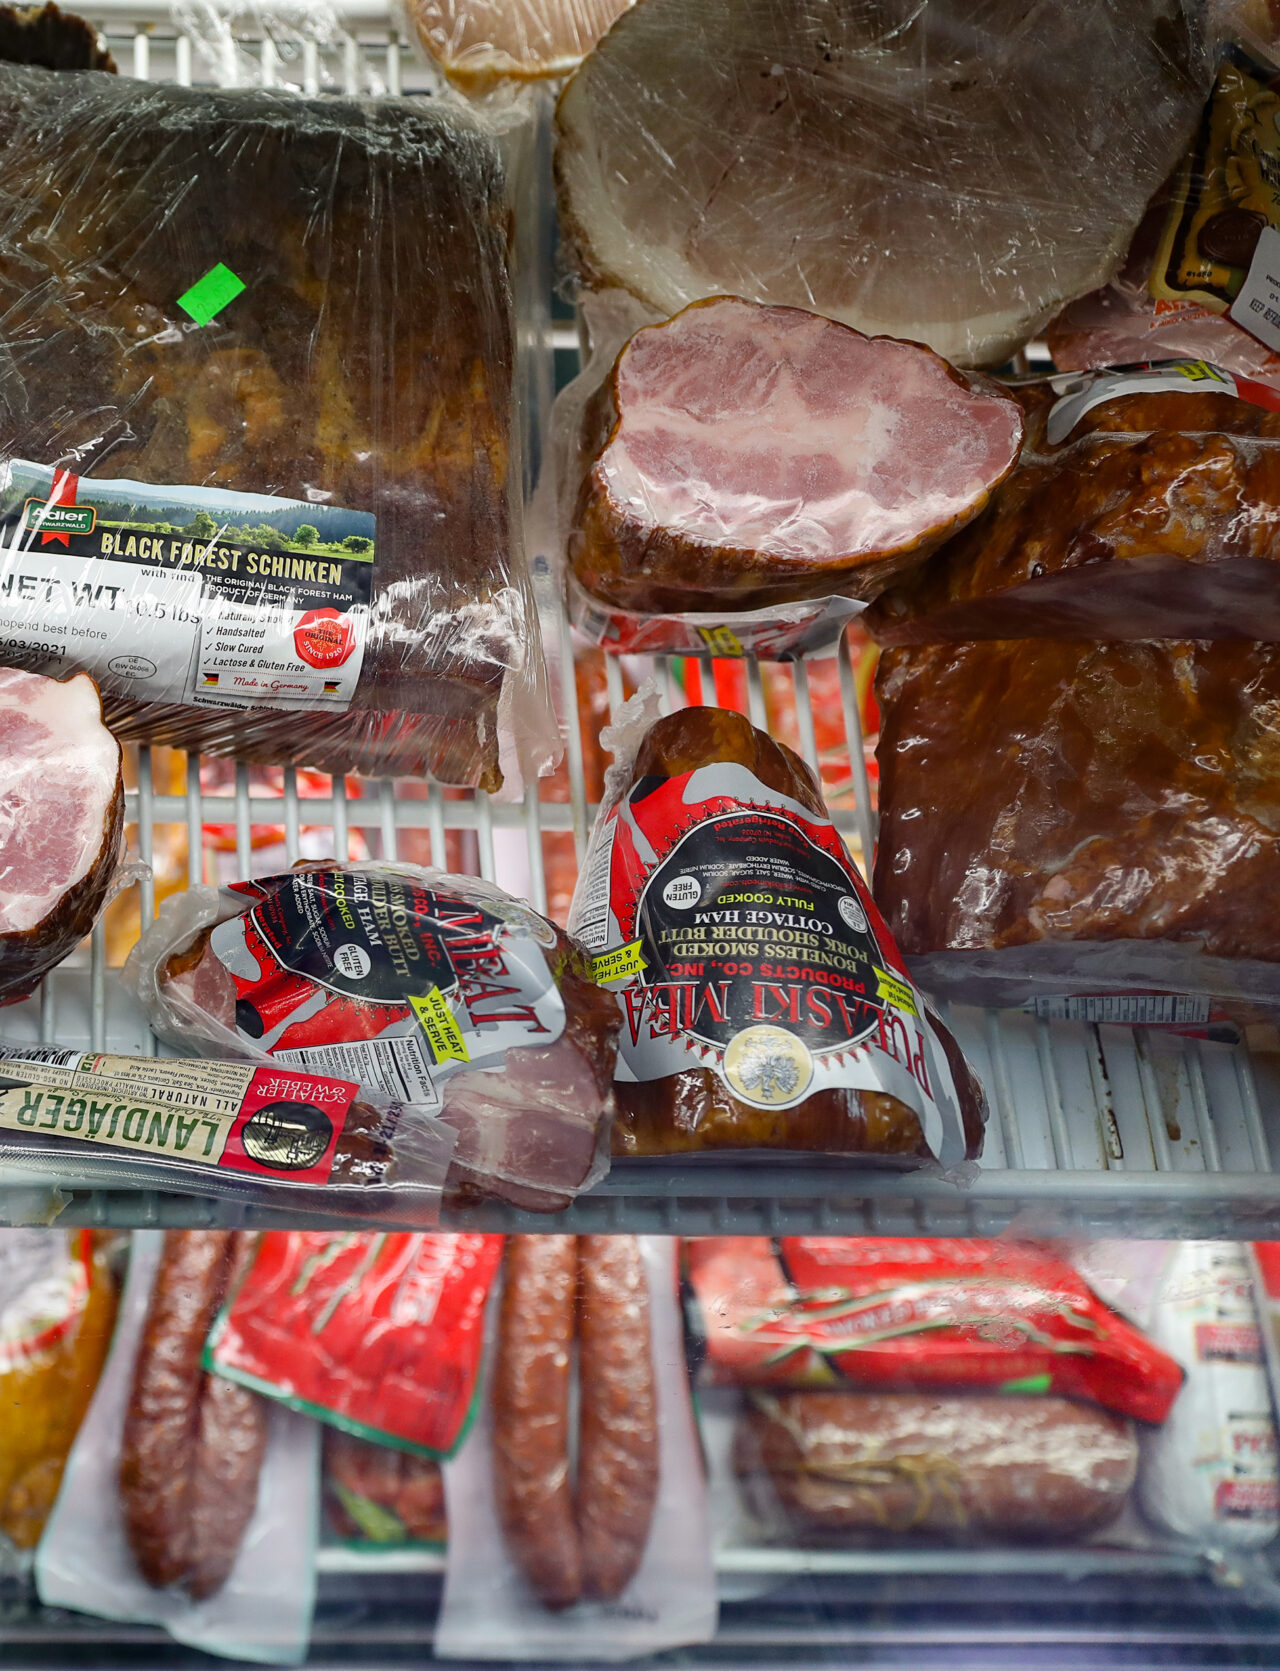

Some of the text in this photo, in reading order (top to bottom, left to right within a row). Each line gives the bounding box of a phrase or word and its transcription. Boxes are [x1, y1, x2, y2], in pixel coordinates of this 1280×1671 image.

[31, 506, 89, 523] Adler
[100, 532, 343, 586] BLACK FOREST SCHINKEN
[140, 568, 167, 580] with
[204, 584, 305, 605] PRODUCT OF GERMANY
[205, 574, 354, 601] THE ORIGINAL BLACK FOREST HAM
[42, 621, 68, 636] best
[215, 626, 266, 639] Handsalted
[304, 631, 344, 646] ORIGINAL
[318, 628, 333, 636] THE
[214, 642, 264, 654] Slow Cured
[303, 640, 343, 660] SINCE 1920
[213, 657, 306, 673] Lactose & Gluten Free
[233, 676, 310, 693] Made in Germany
[192, 695, 249, 710] Schwarzwälder
[699, 863, 726, 871] SODIUM
[769, 856, 789, 865] WATER
[729, 868, 754, 876] SUGAR,
[665, 889, 700, 901] GLUTEN
[672, 883, 694, 892] FREE
[293, 893, 303, 915] ADDED
[335, 883, 357, 931] COOKED
[717, 892, 815, 912] FULLY COOKED
[357, 906, 384, 948] HAM
[693, 909, 740, 925] HAM
[745, 911, 834, 937] COTTAGE
[419, 932, 442, 967] INC.
[657, 926, 870, 964] PORK SHOULDER BUTT
[339, 951, 354, 973] FREE
[346, 944, 365, 977] GLUTEN
[383, 933, 411, 978] BUTT
[591, 949, 633, 967] & SERVE
[673, 941, 859, 974] BONELESS SMOKED
[614, 959, 640, 973] JUST
[665, 960, 867, 995] PRODUCTS CO., INC.
[612, 980, 733, 1048] MEA
[418, 1005, 448, 1053] & SERVE
[428, 995, 465, 1055] JUST HEAT
[749, 980, 934, 1102] PULASKI
[15, 1071, 69, 1086] NO MSG-GLUTEN
[129, 1064, 199, 1082] Natural Acid
[405, 1039, 431, 1098] Nutrition Facts
[75, 1074, 120, 1087] PROCESSED
[269, 1077, 347, 1097] &WEBER
[150, 1088, 239, 1112] ALL NATURAL
[256, 1083, 347, 1104] SCHALLER
[16, 1089, 221, 1157] LANDJÄGER
